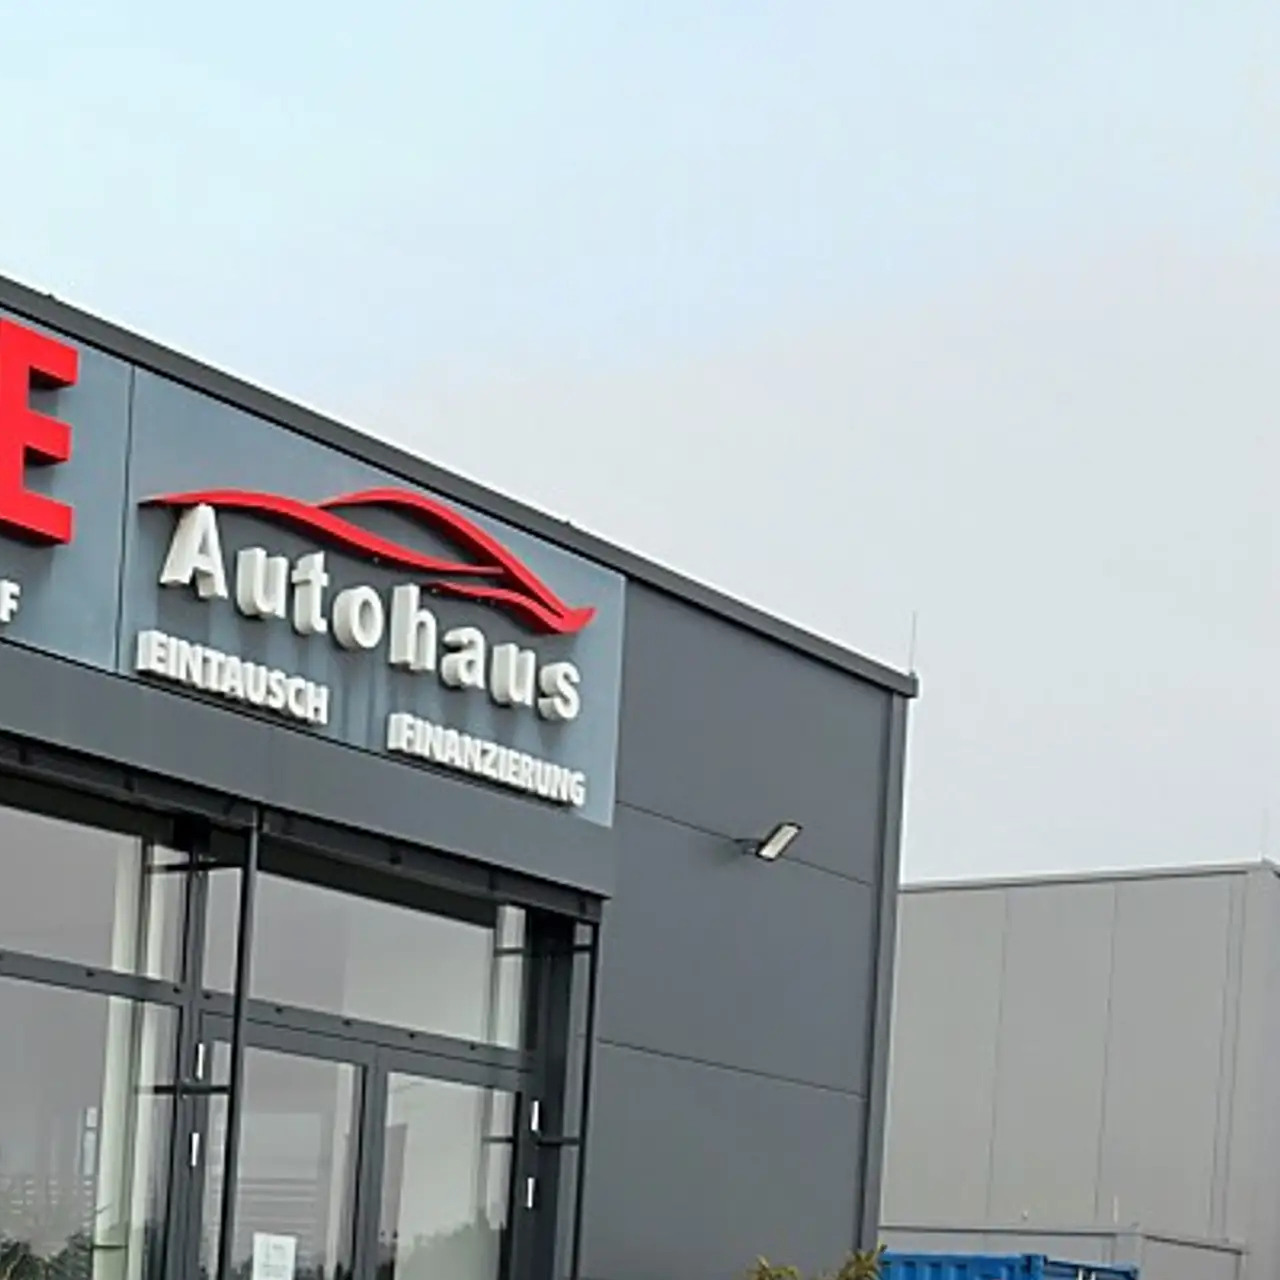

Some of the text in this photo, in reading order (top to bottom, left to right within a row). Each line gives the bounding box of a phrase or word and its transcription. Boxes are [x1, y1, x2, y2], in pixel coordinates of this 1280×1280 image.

[159, 502, 583, 722] Autohaus
[134, 630, 329, 726] EINTAUSCH
[386, 713, 586, 808] FINANZIERUNG
